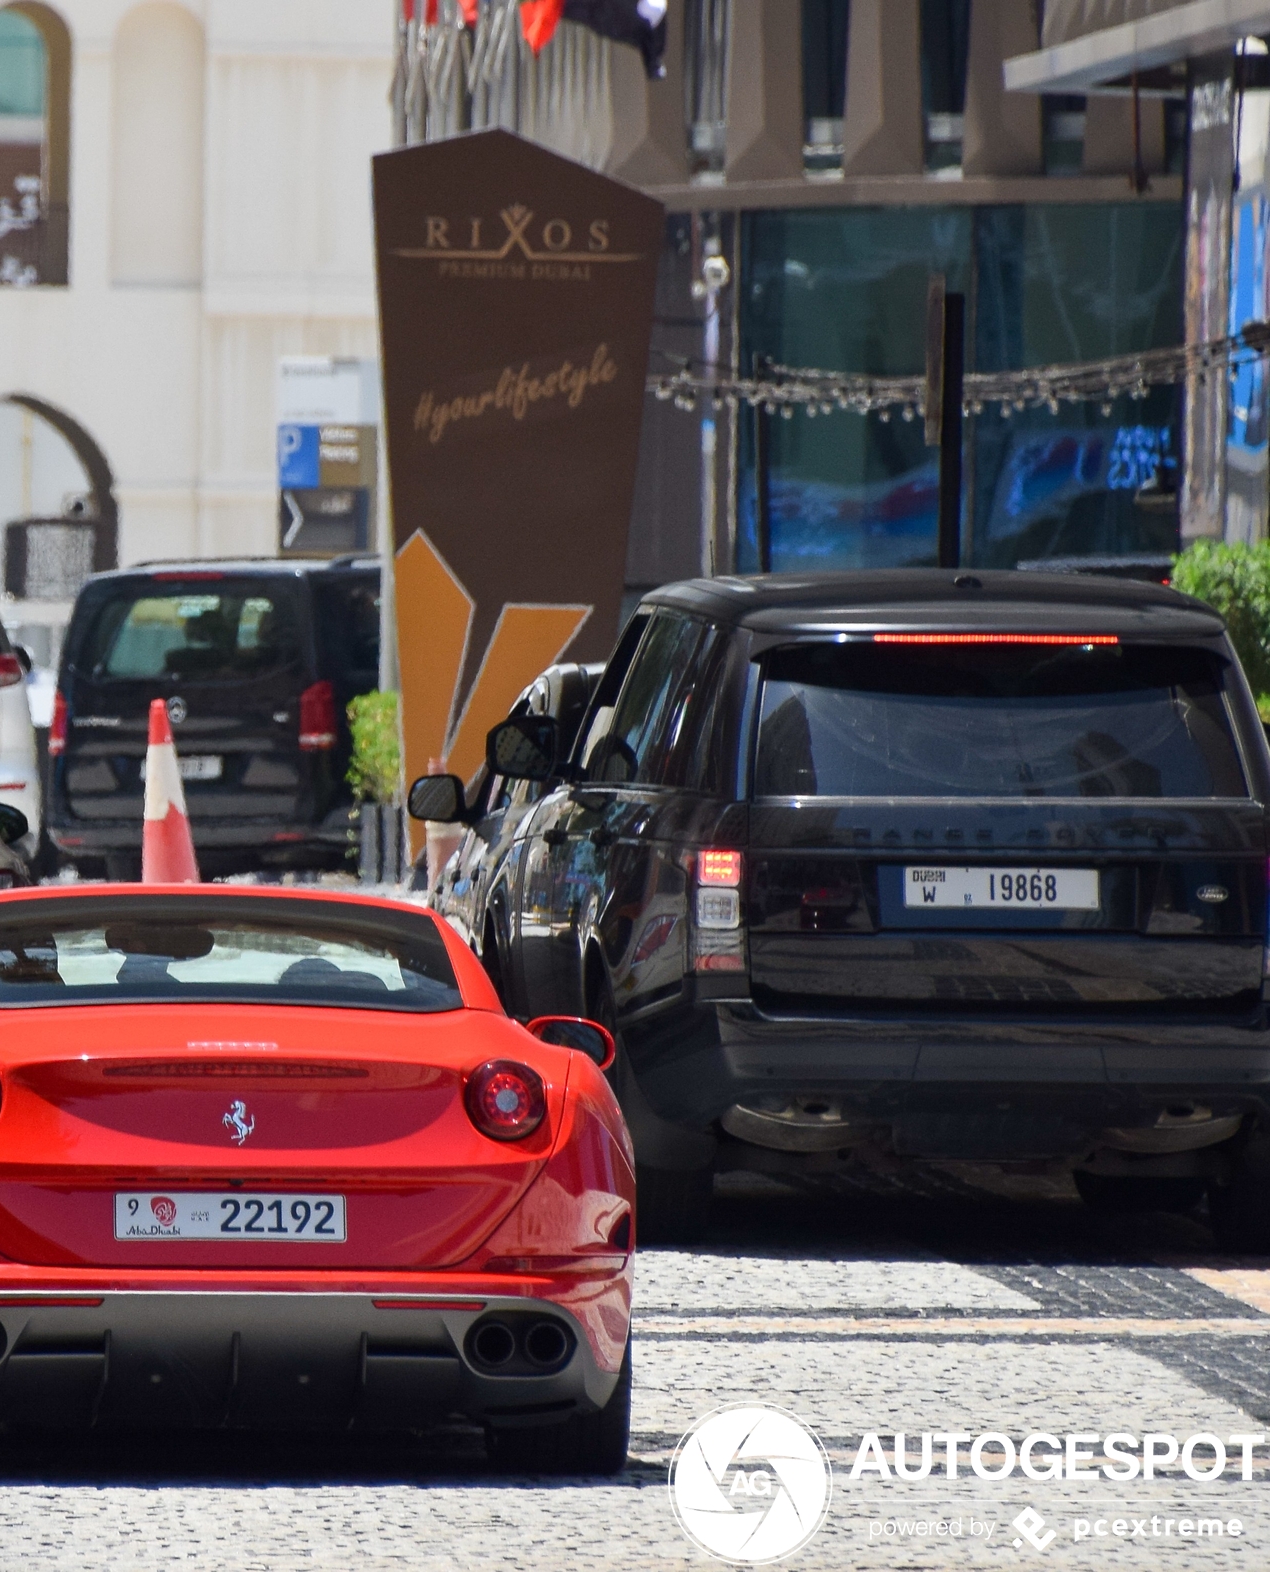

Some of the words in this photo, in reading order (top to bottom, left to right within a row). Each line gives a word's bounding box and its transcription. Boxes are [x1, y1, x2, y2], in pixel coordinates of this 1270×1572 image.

[426, 204, 610, 252] RIXOS
[439, 261, 526, 279] PREMIUM
[532, 263, 592, 281] DUBAI
[912, 869, 947, 883] DUBAI
[922, 886, 936, 903] W
[989, 873, 1058, 902] 19868
[128, 1198, 139, 1217] 9
[220, 1199, 336, 1235] 22192
